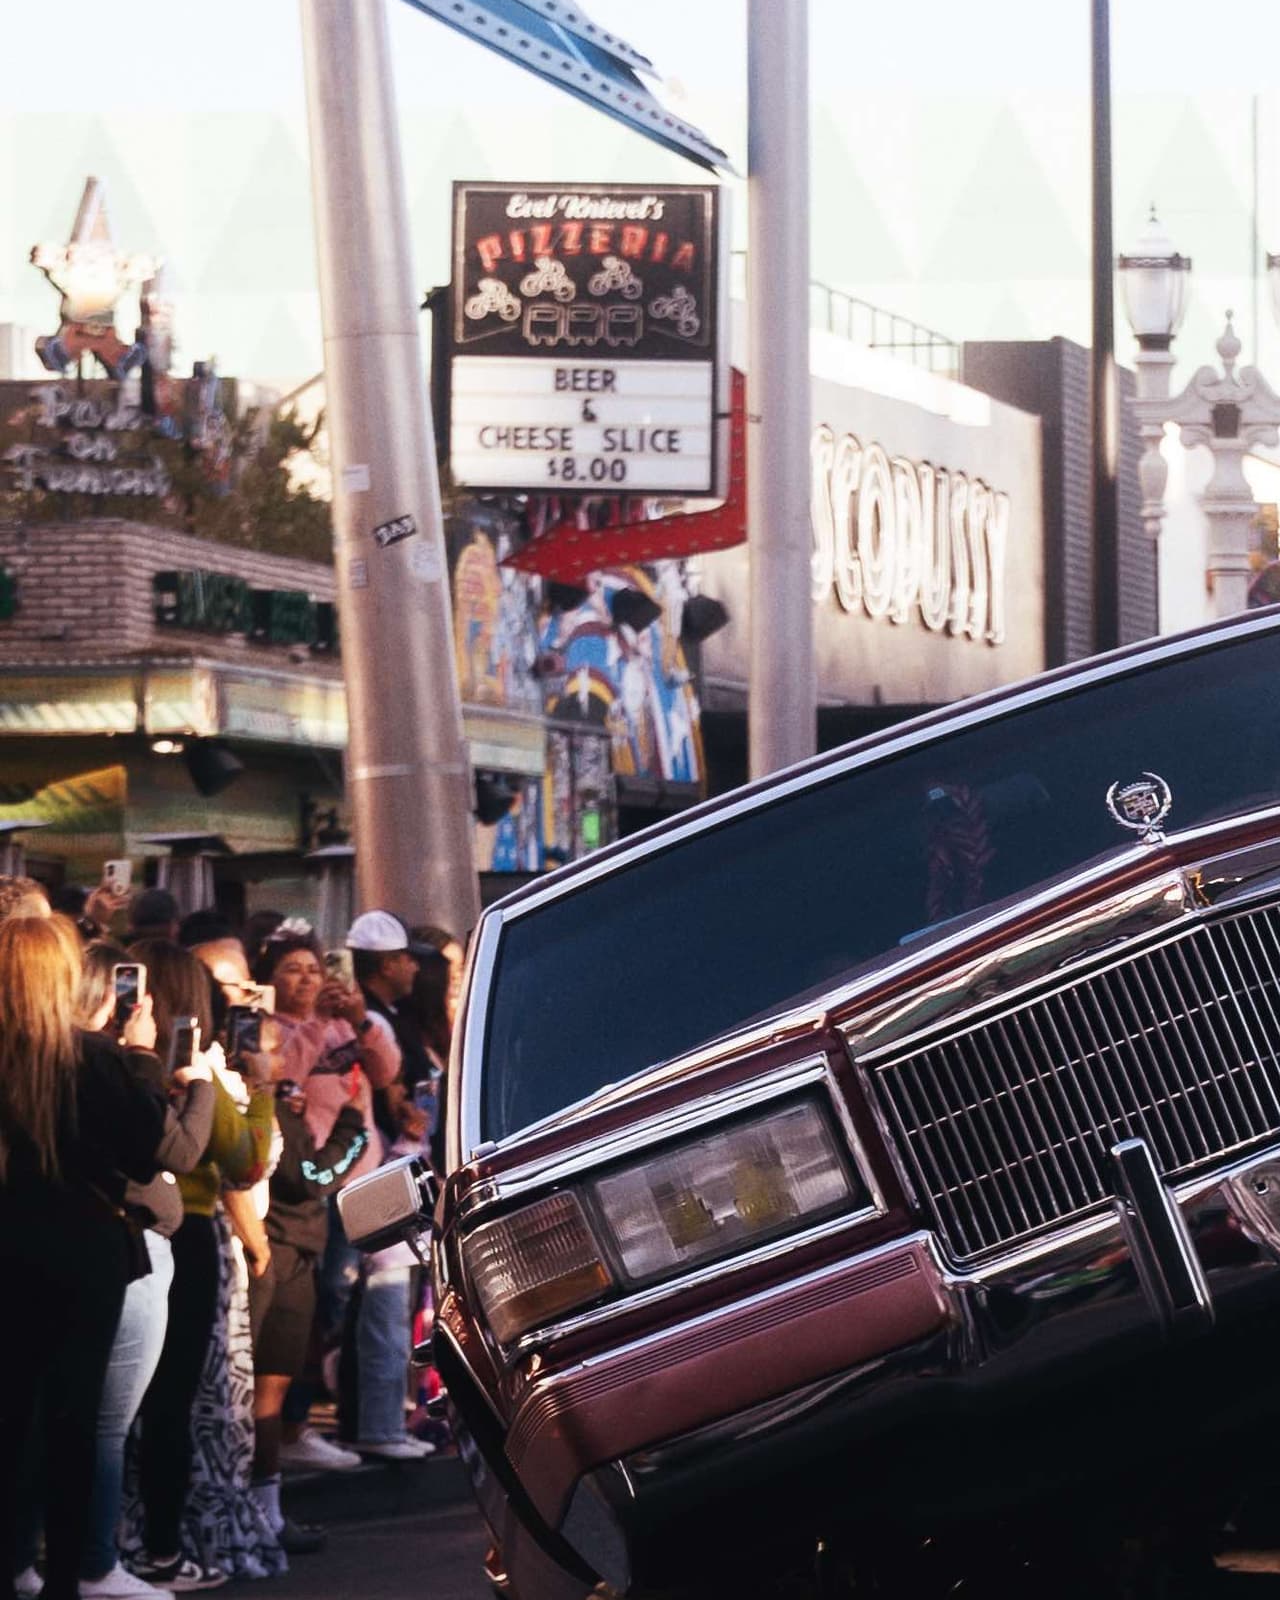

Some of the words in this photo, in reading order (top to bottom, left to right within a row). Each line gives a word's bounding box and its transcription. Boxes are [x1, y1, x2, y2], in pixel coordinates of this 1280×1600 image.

[477, 221, 696, 274] PIZZERIA
[554, 368, 617, 392] BEER
[582, 399, 597, 423] &
[479, 427, 574, 451] CHEESE
[603, 428, 681, 453] SLICE
[548, 458, 627, 482] $8.00
